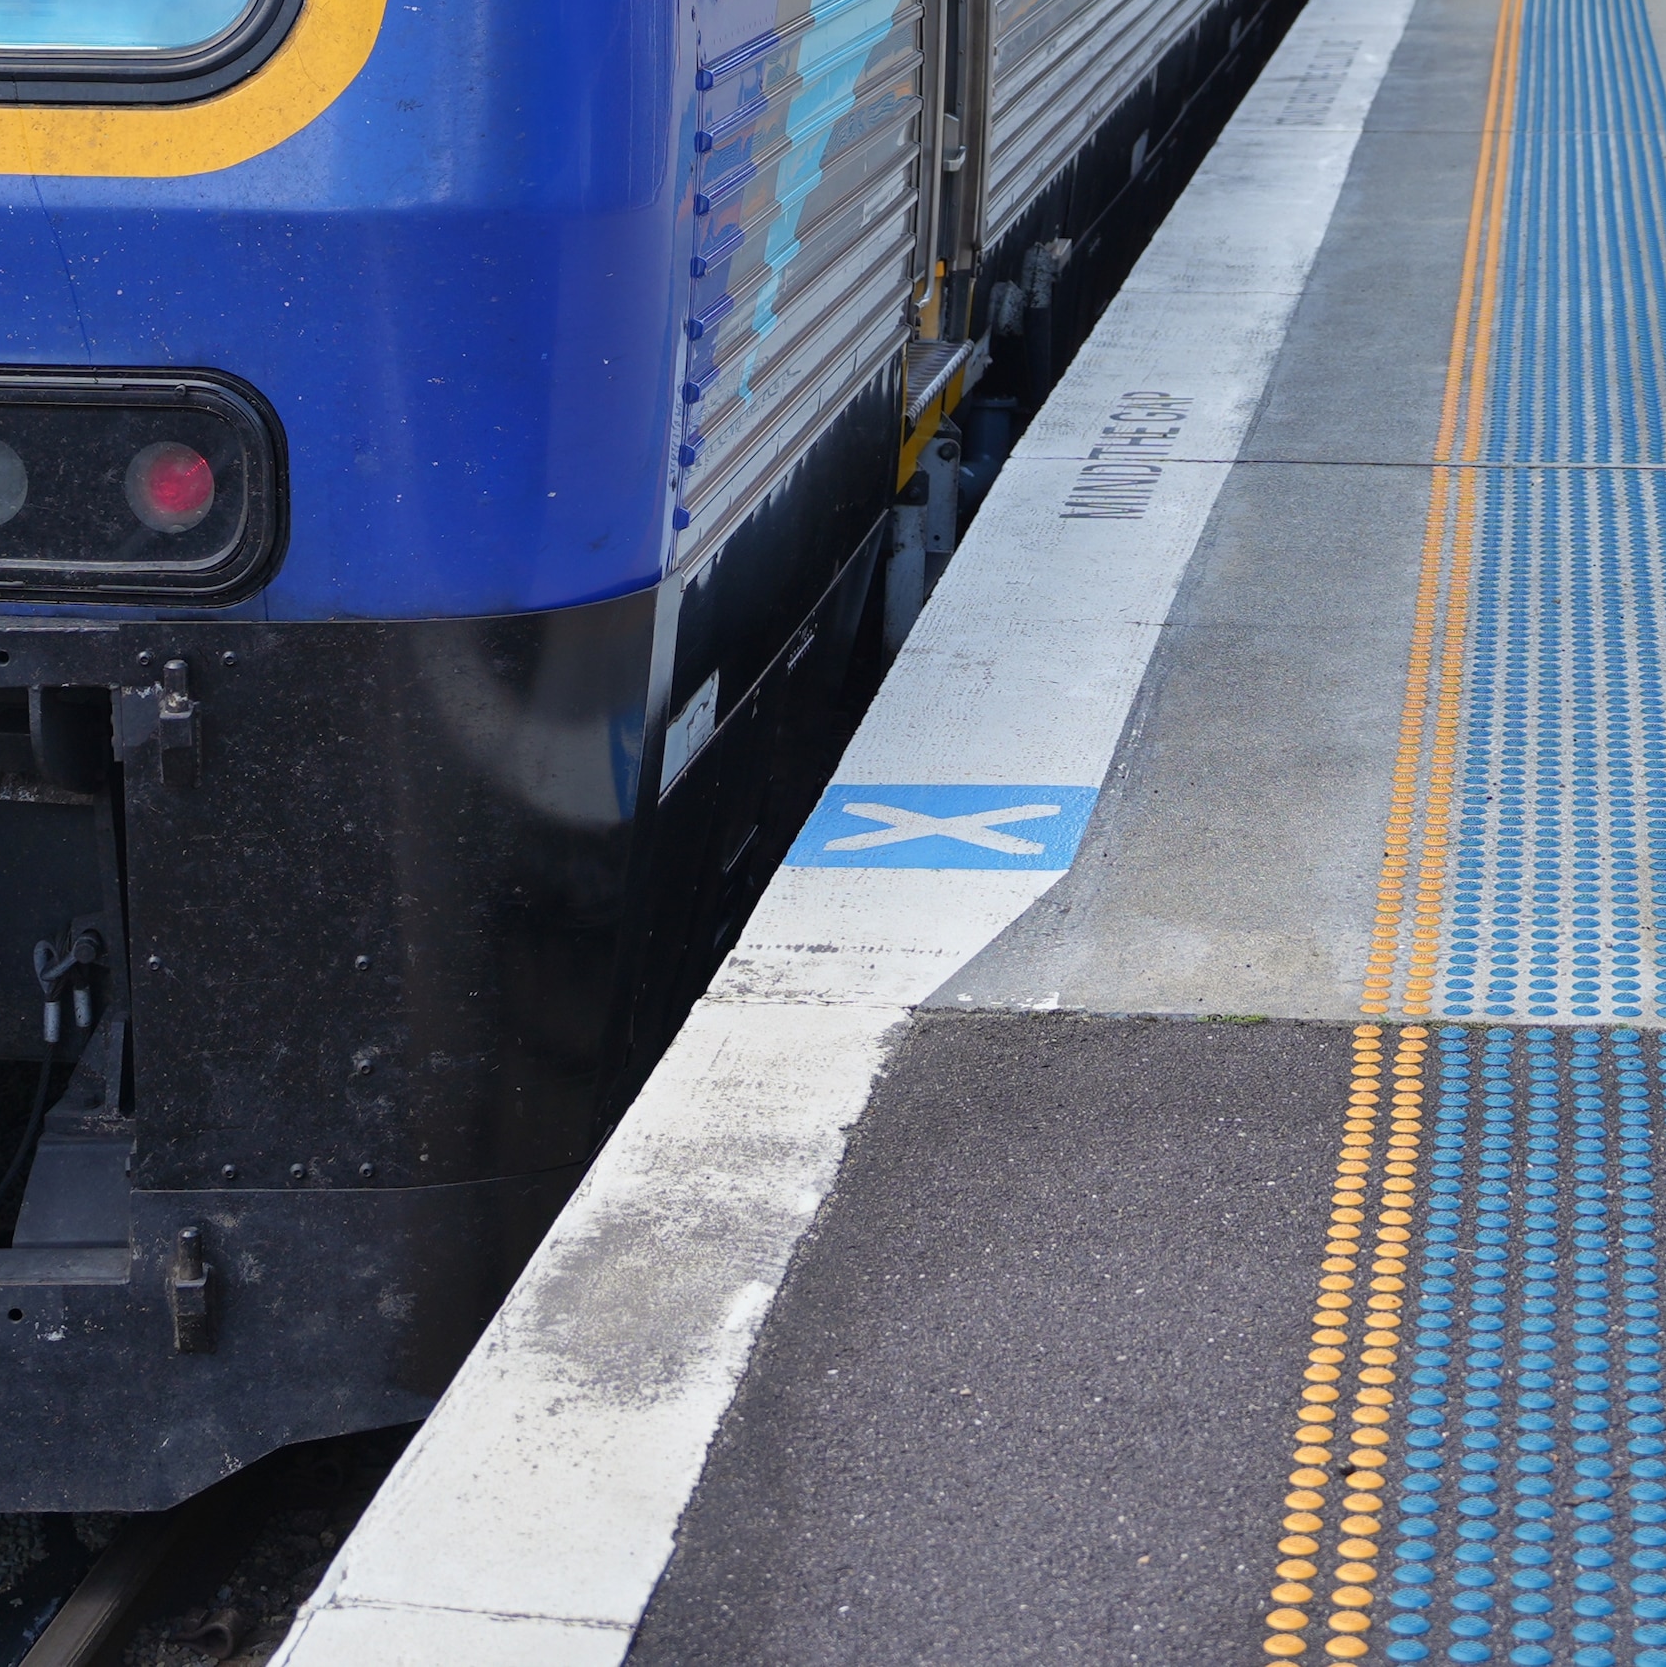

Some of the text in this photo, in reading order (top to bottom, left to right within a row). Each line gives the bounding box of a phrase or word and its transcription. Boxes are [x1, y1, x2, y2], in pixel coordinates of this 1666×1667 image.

[1059, 391, 1194, 519] MIND THE GAP
